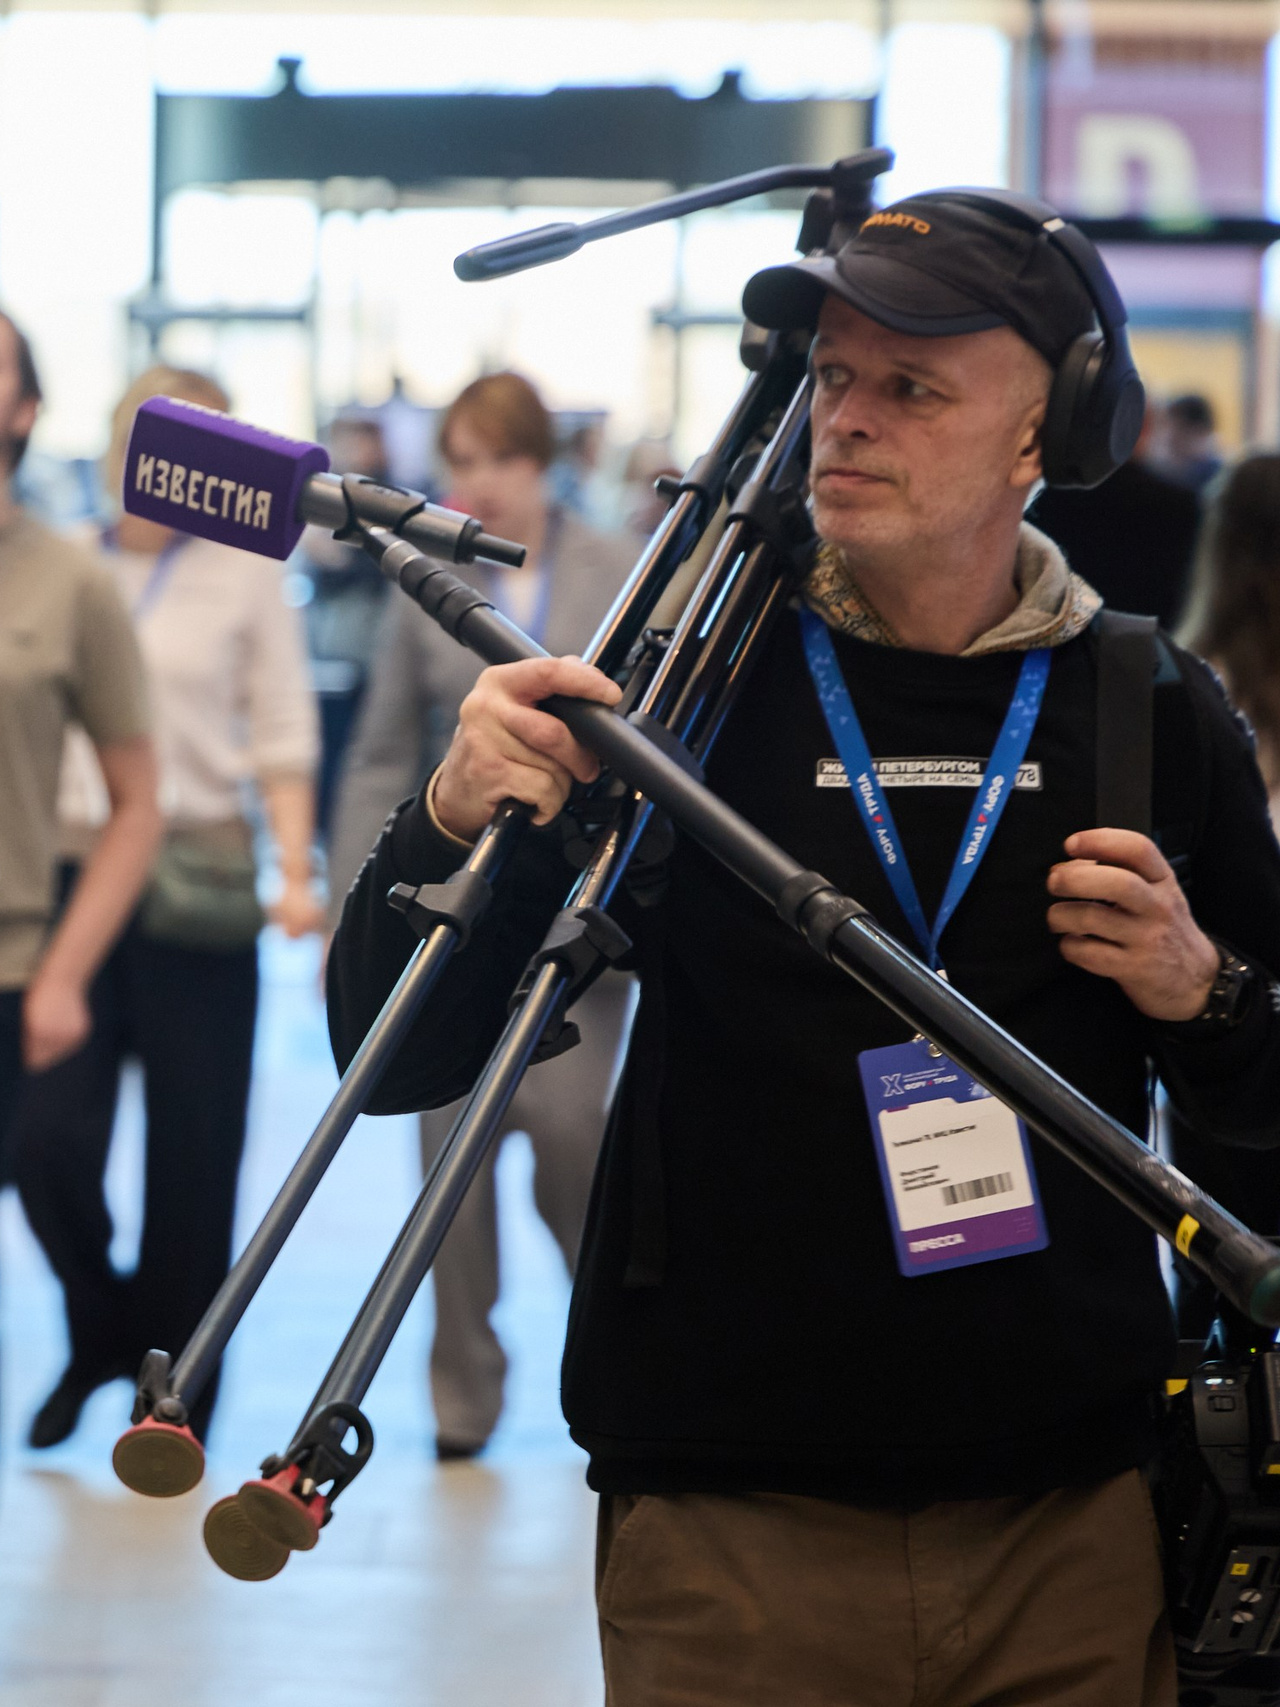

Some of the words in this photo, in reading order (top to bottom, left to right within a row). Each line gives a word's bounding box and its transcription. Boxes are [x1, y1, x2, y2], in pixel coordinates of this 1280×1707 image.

[135, 453, 273, 531] ИЗВЕСТИЯ
[879, 760, 980, 774] ПЕТЕРБУРГОМ
[1016, 768, 1037, 783] 78
[857, 772, 880, 815] ТРУДА
[962, 825, 987, 864] ТРУДА
